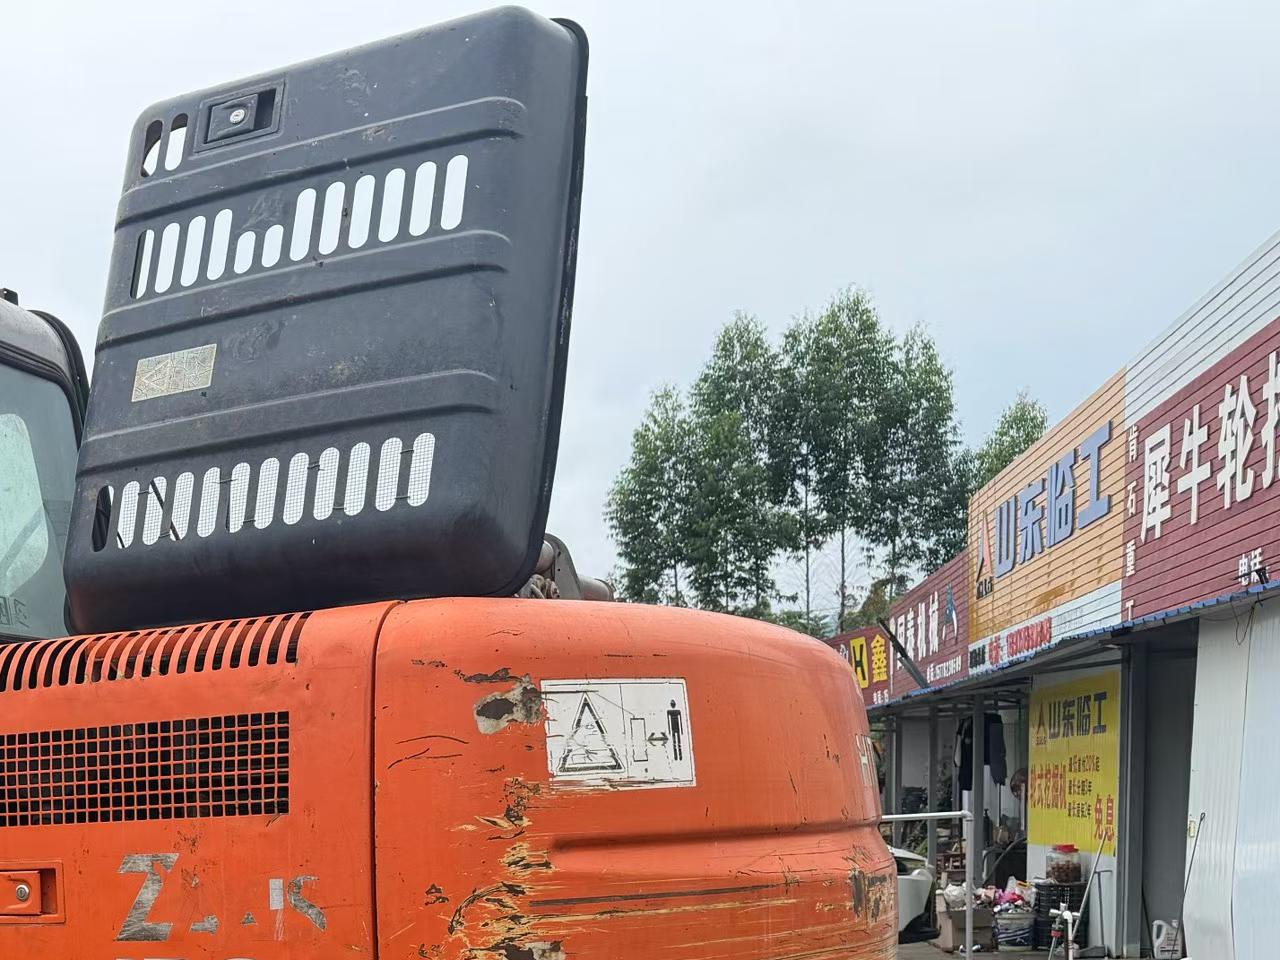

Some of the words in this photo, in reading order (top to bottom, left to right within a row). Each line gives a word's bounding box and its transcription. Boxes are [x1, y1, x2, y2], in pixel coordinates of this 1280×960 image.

[994, 419, 1112, 579] 山东临工
[1048, 691, 1107, 740] 山东临工
[1094, 794, 1115, 842] 免息
